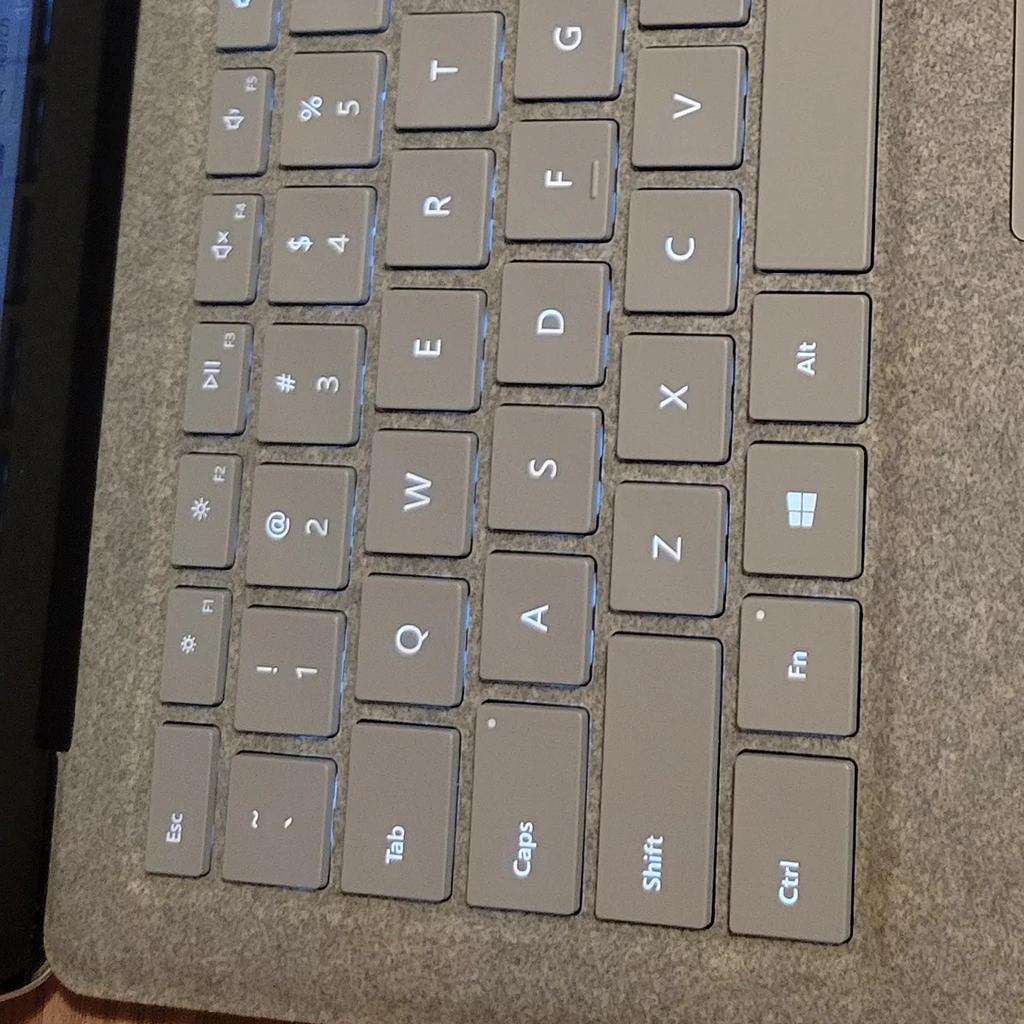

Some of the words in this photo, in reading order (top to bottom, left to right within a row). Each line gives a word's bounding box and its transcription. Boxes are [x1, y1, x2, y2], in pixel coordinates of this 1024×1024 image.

[553, 26, 582, 51] G
[430, 59, 459, 82] T
[245, 75, 258, 92] F5
[299, 96, 323, 122] %
[336, 100, 360, 116] 5
[672, 93, 702, 119] V
[544, 170, 573, 188] F
[233, 203, 247, 220] F4
[423, 196, 452, 216] R
[287, 236, 313, 252] $
[327, 234, 350, 253] 4
[665, 237, 695, 262] C
[536, 309, 565, 335] D
[223, 332, 236, 349] F3
[413, 339, 442, 357] E
[796, 341, 817, 376] Alt
[275, 373, 296, 393] #
[316, 376, 339, 393] 3
[659, 384, 689, 410] X
[212, 465, 226, 482] F2
[528, 459, 557, 479] S
[403, 472, 432, 512] W
[265, 511, 290, 539] @
[305, 519, 329, 537] 2
[652, 534, 682, 561] Z
[201, 599, 215, 613] F1
[520, 604, 549, 632] A
[395, 624, 429, 655] Q
[295, 667, 318, 679] 1
[787, 651, 808, 679] Fn
[165, 813, 183, 843] Esc
[385, 825, 405, 865] Tab
[512, 821, 537, 878] Caps
[642, 835, 664, 892] Shift
[778, 860, 800, 905] Ctrl
